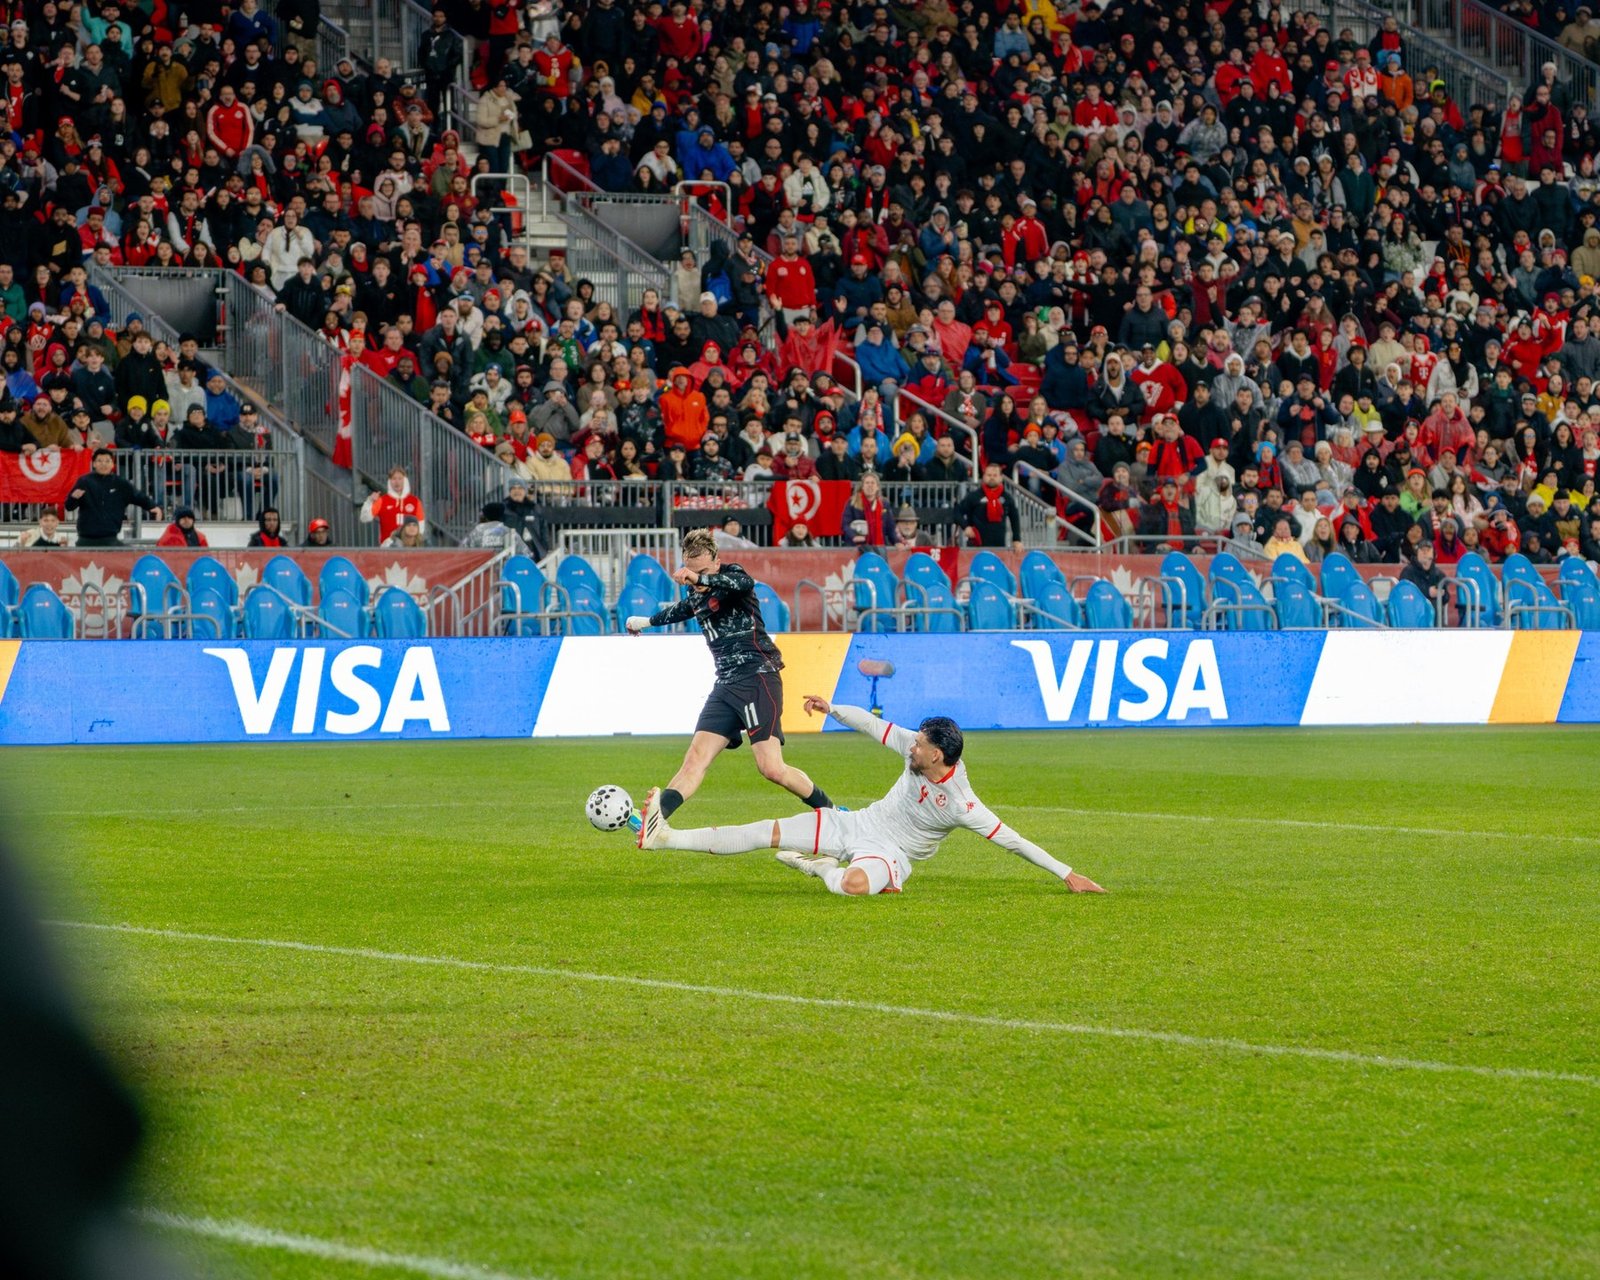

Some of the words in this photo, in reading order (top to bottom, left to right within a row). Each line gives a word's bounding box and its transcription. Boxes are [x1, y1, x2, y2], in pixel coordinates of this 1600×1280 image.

[203, 645, 450, 735] VISA
[744, 702, 759, 729] 11
[1010, 638, 1228, 722] VISA
